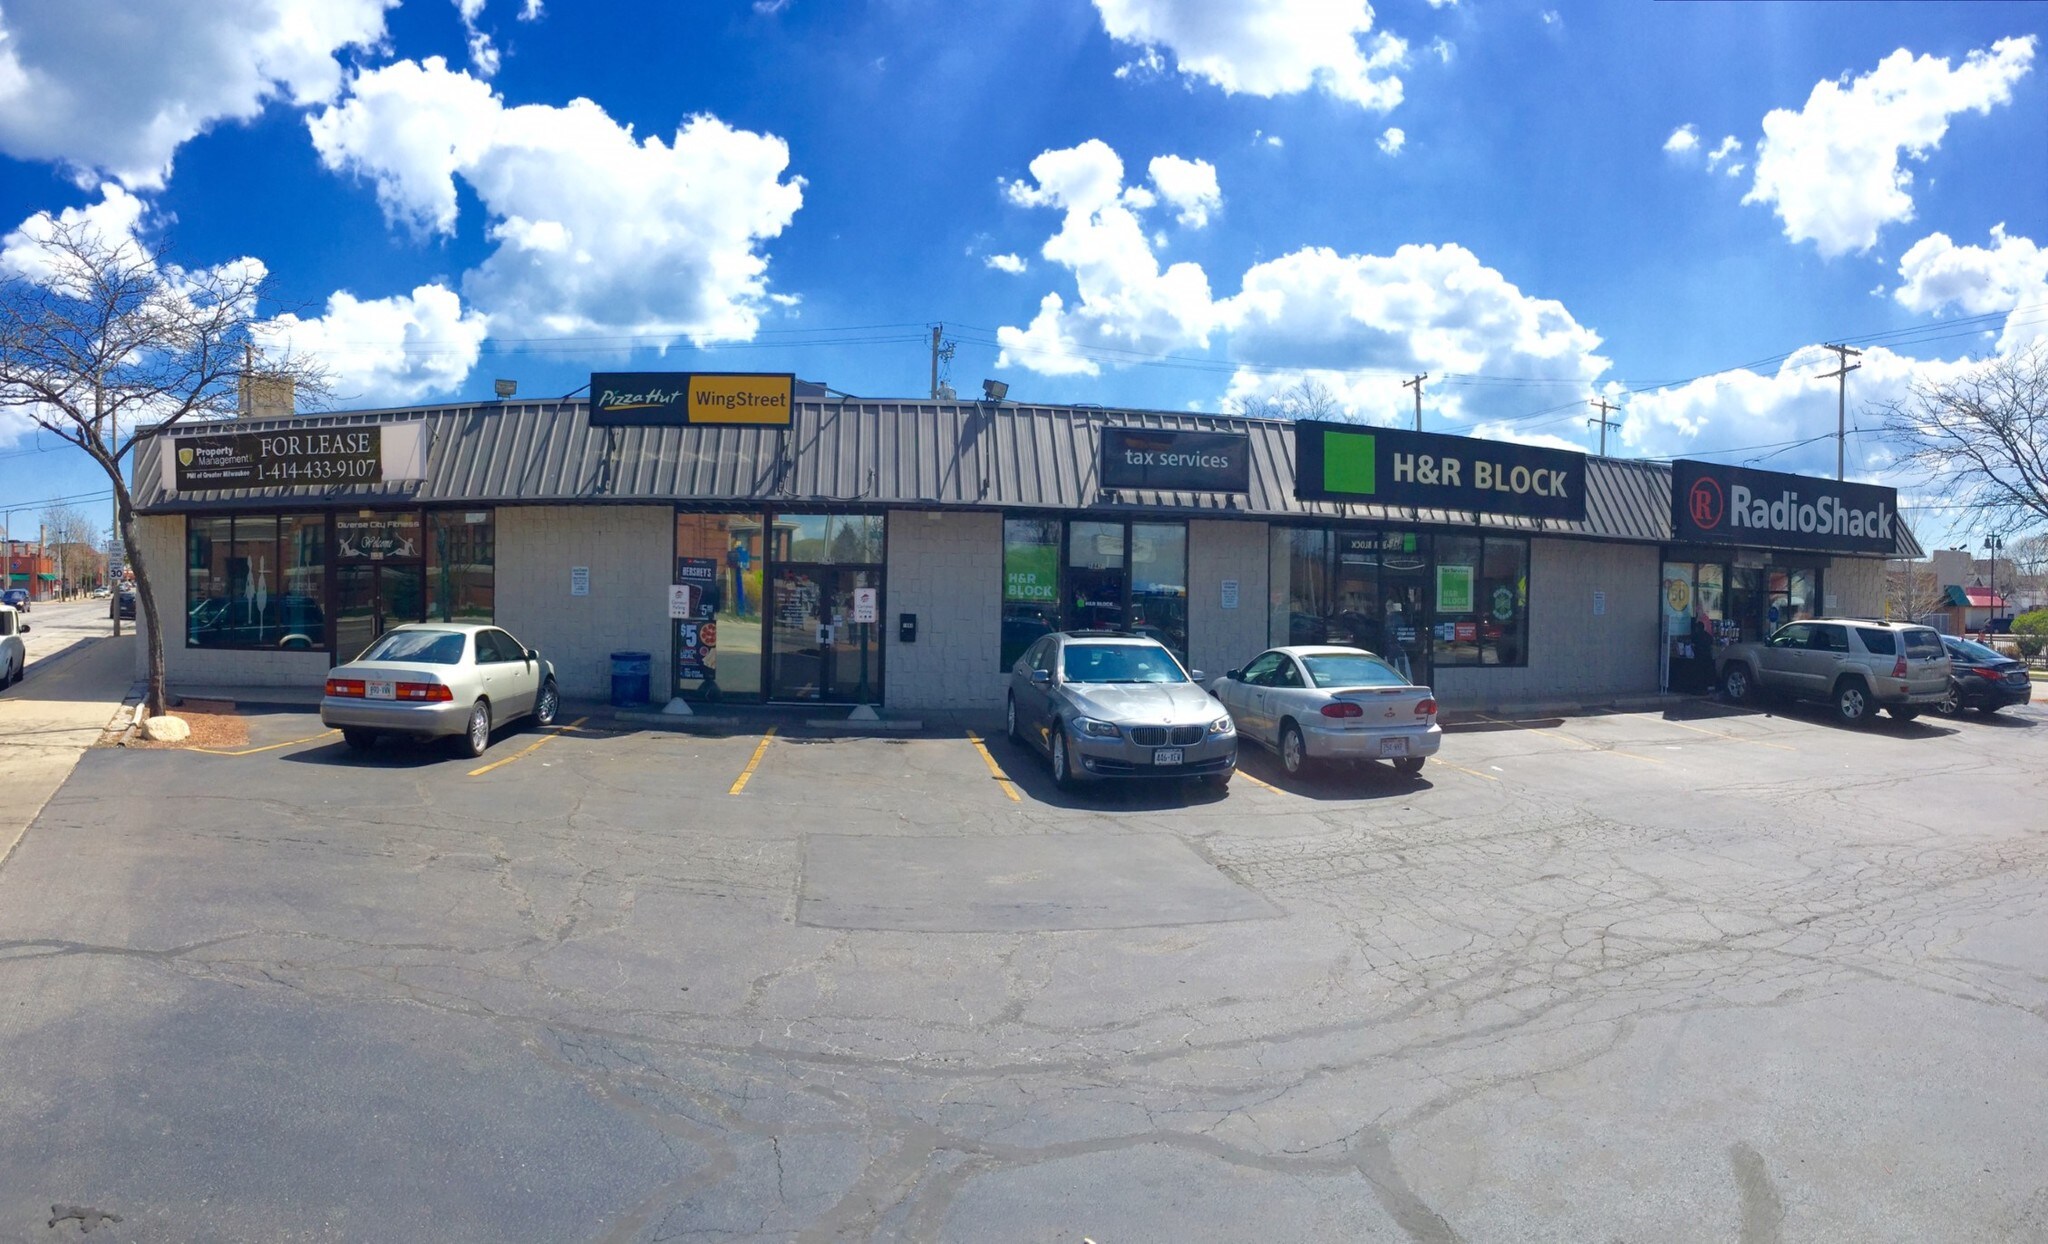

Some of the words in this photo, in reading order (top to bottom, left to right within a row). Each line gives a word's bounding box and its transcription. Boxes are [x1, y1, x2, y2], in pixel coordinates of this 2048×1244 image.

[599, 390, 643, 407] Pizza
[646, 389, 683, 404] Hut
[696, 391, 786, 409] WingStreet
[196, 446, 233, 458] Property
[260, 437, 300, 458] FOR
[306, 434, 371, 456] LEASE
[198, 454, 249, 467] Management
[1125, 449, 1154, 466] tax
[1159, 450, 1229, 468] services
[203, 471, 222, 479] Greater
[223, 470, 250, 478] Milwaukee
[258, 459, 376, 481] 1-414-433-9107
[1394, 453, 1462, 487] H&R
[1475, 460, 1568, 498] BLOCK
[1731, 484, 1893, 539] RadioShack
[337, 521, 369, 529] Diverse
[370, 521, 385, 529] City
[111, 569, 123, 578] 30
[682, 566, 712, 578] HERSHEY'S
[1008, 573, 1037, 584] H&R
[1008, 585, 1053, 598] BLOCK
[680, 624, 697, 647] $5
